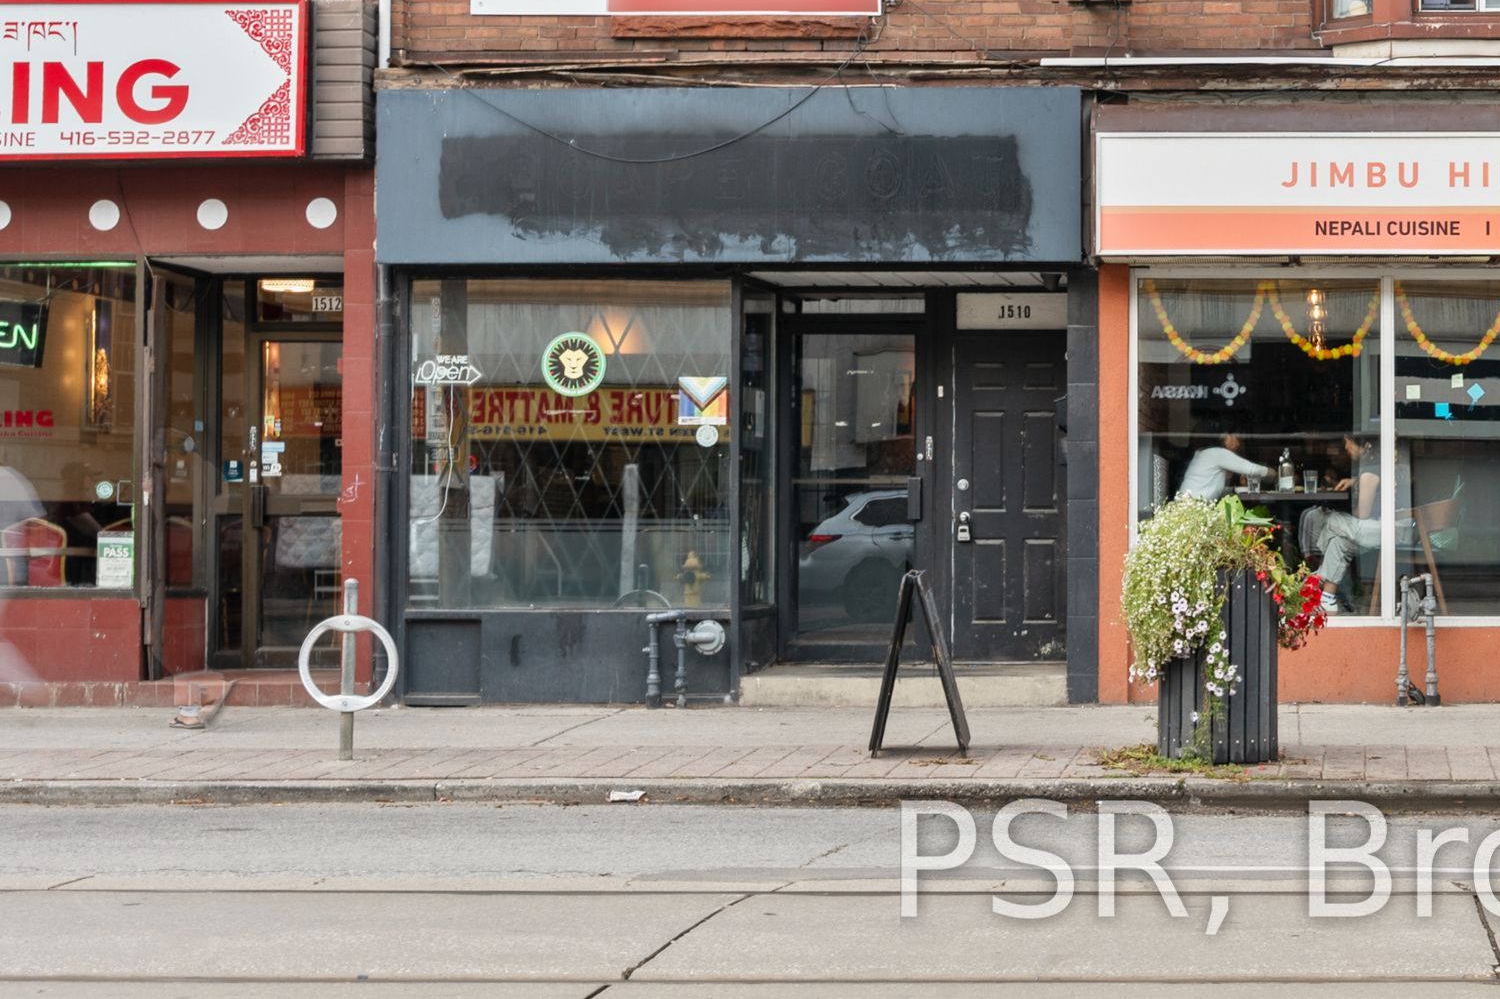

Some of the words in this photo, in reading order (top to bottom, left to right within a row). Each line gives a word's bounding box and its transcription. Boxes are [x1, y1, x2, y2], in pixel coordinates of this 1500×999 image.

[60, 130, 216, 146] 416-532-2877
[1281, 161, 1421, 189] JIMBU
[1314, 220, 1382, 238] NEPALI
[1386, 220, 1461, 238] CUISINE
[313, 297, 341, 311] 1512
[999, 305, 1031, 319] 1510
[420, 361, 472, 381] Open
[103, 547, 129, 558] PASS
